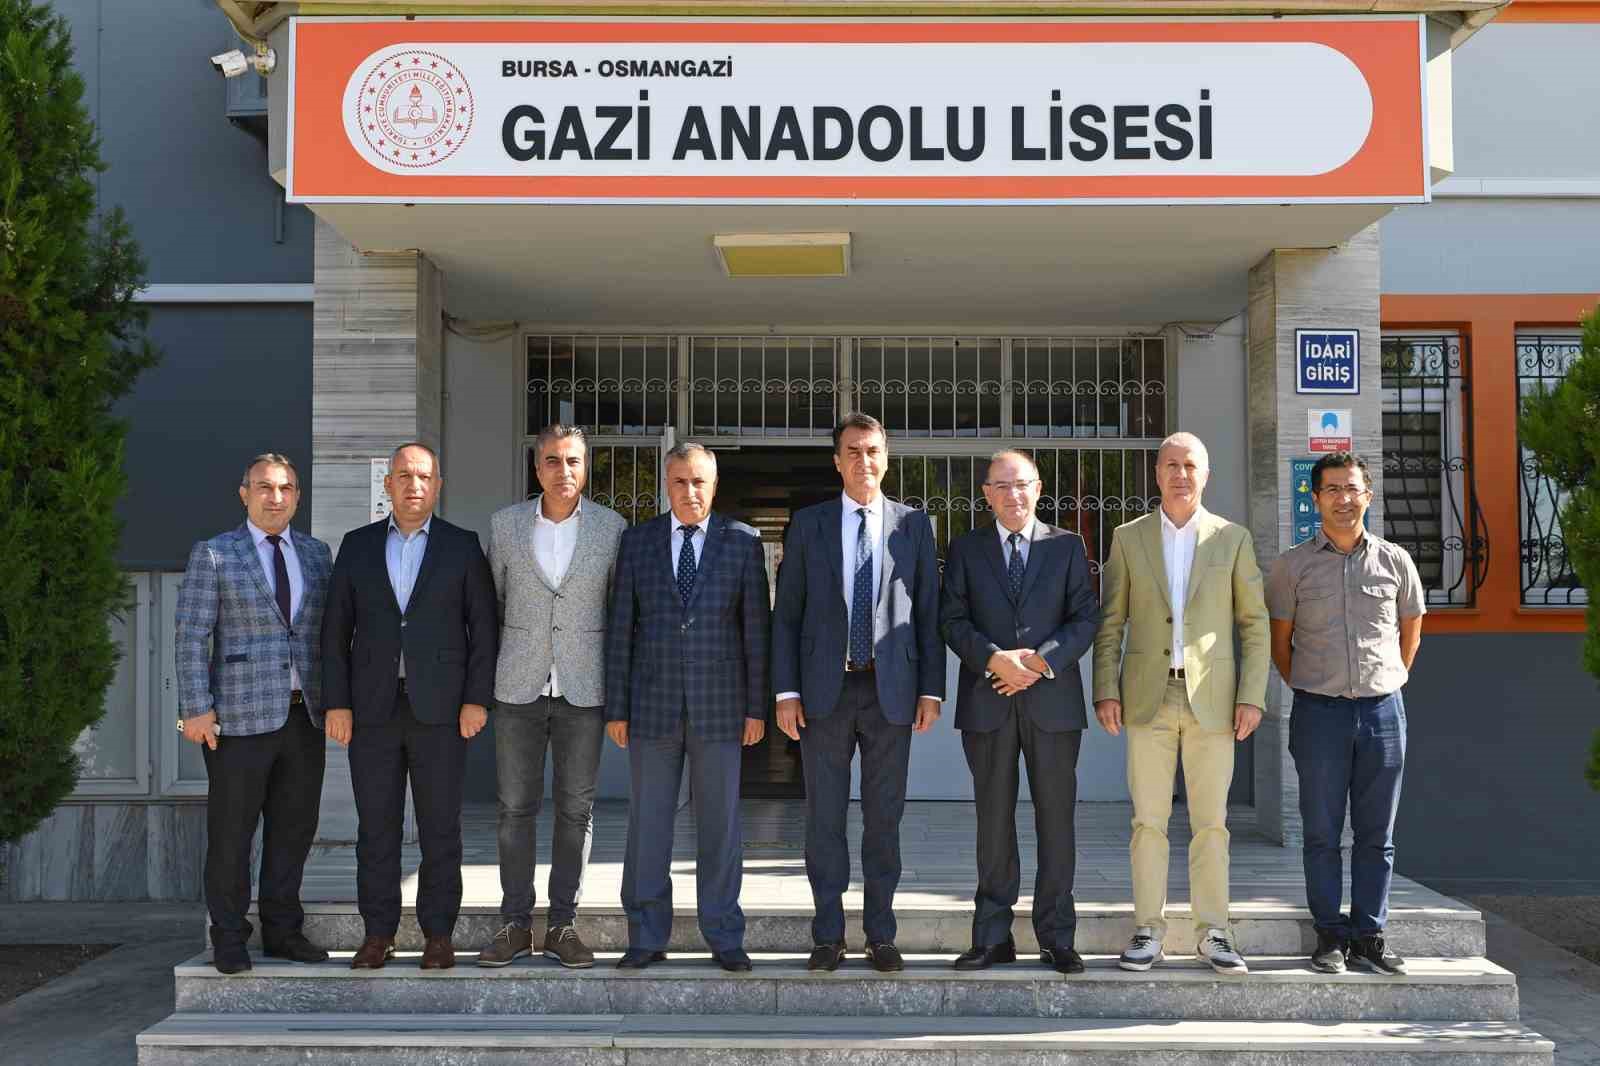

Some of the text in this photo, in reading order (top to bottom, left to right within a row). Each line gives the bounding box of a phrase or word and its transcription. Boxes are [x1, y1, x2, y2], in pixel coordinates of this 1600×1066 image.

[502, 60, 578, 78] BURSA
[597, 55, 733, 78] OSMANGAZİ
[501, 88, 1213, 163] GAZİ ANADOLU LİSESİ
[1305, 340, 1350, 359] İDARİ
[1306, 362, 1350, 384] GİRİŞ
